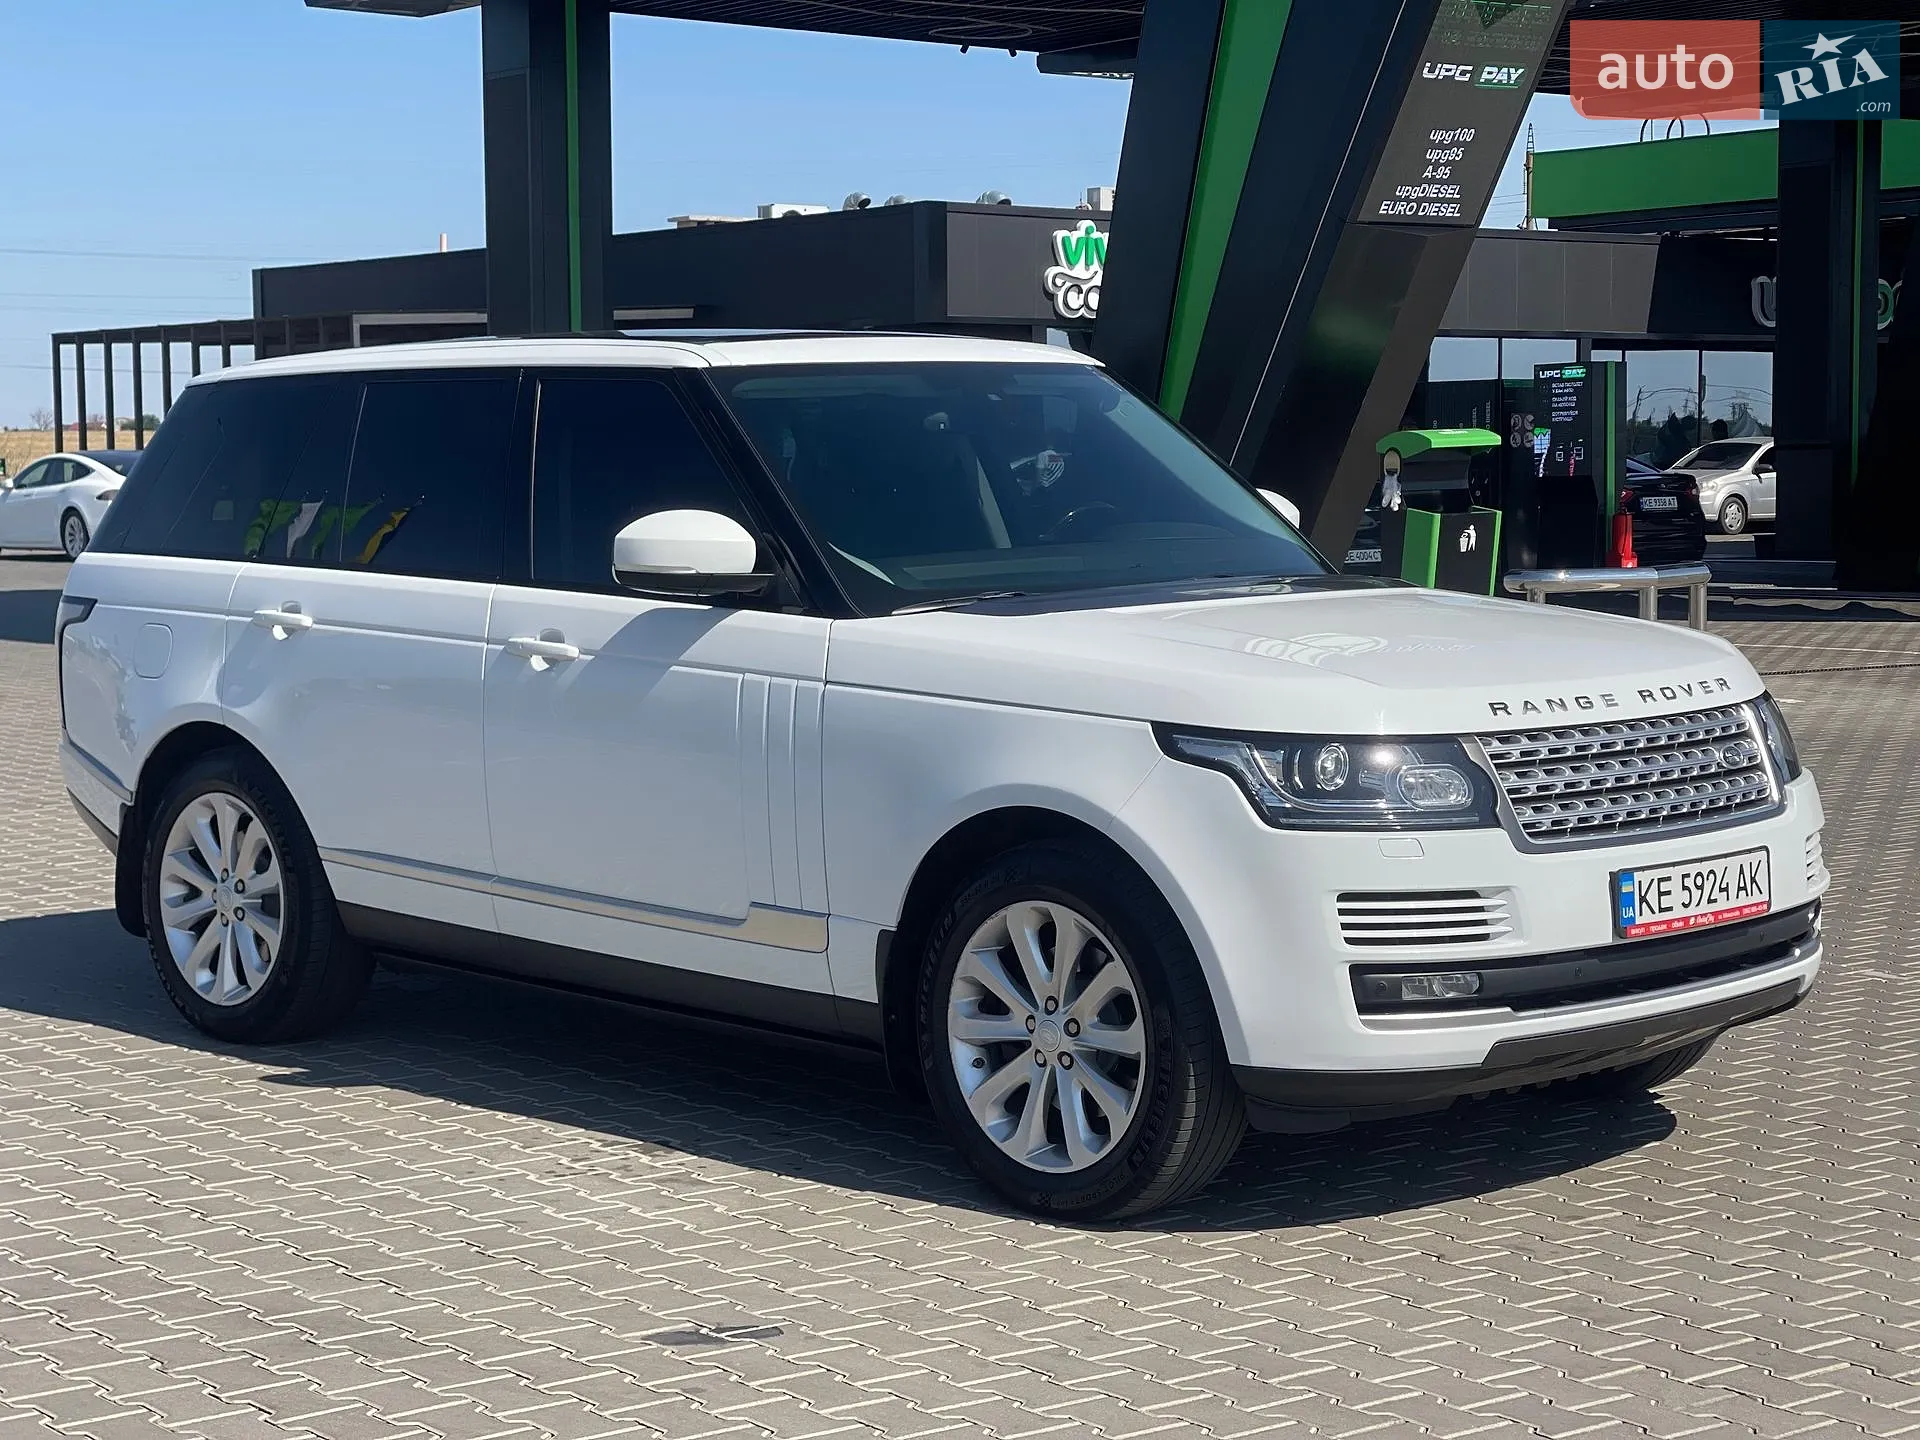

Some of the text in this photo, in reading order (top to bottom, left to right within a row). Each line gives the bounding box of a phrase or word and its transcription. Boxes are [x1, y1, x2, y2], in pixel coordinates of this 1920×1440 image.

[1422, 62, 1525, 83] UPG PAY
[1429, 127, 1475, 144] upg100
[1426, 147, 1464, 163] upg95
[1422, 165, 1452, 179] A-95
[1395, 183, 1460, 199] upgDIESEL
[1379, 200, 1460, 217] EURO DIESEL
[1539, 370, 1561, 378] UPG
[1488, 677, 1732, 717] RANGE ROVER
[1637, 859, 1763, 917] KE 5924 AK
[1622, 906, 1635, 918] UA
